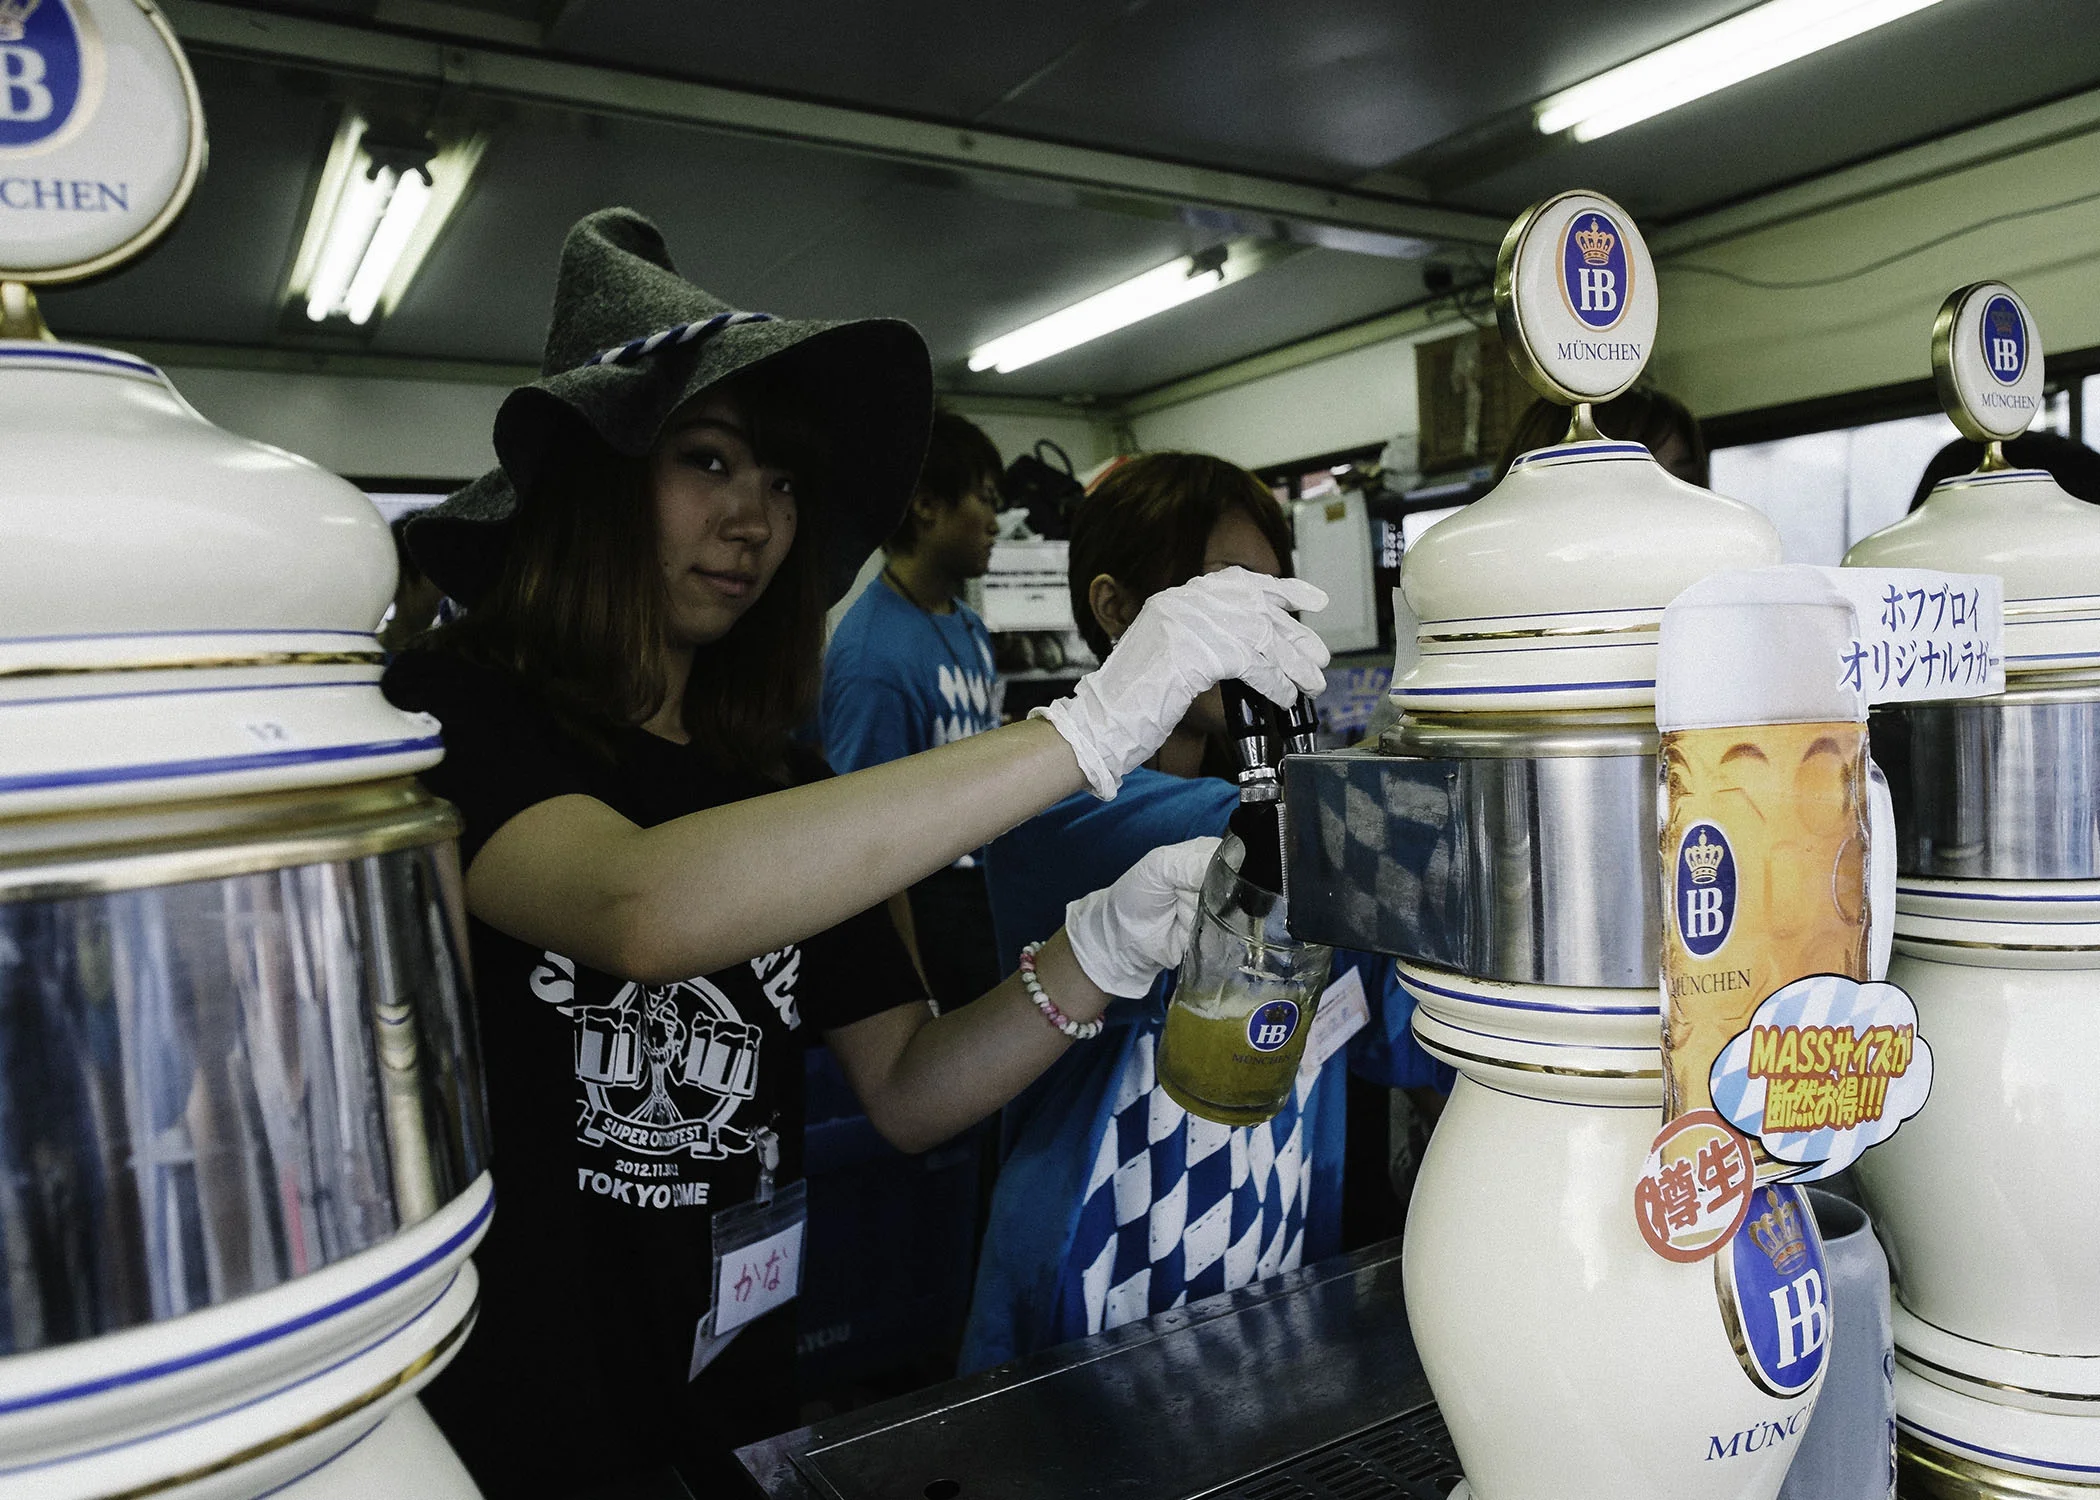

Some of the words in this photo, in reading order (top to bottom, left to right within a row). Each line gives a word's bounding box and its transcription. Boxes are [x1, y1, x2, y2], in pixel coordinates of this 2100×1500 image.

[1578, 268, 1617, 312] HB
[1557, 340, 1641, 361] MÜNCHEN
[1993, 338, 2019, 372] HB
[1981, 392, 2036, 409] MÜNCHEN
[1881, 582, 1980, 633] ホフブロイ
[1839, 639, 2000, 692] オリジナルラガー
[1686, 887, 1724, 938] HB
[1256, 1023, 1288, 1045] HB
[601, 1117, 648, 1147] SUPER
[577, 1167, 671, 1210] TOKYO
[734, 1247, 789, 1302] かな
[1769, 1268, 1827, 1369] HB
